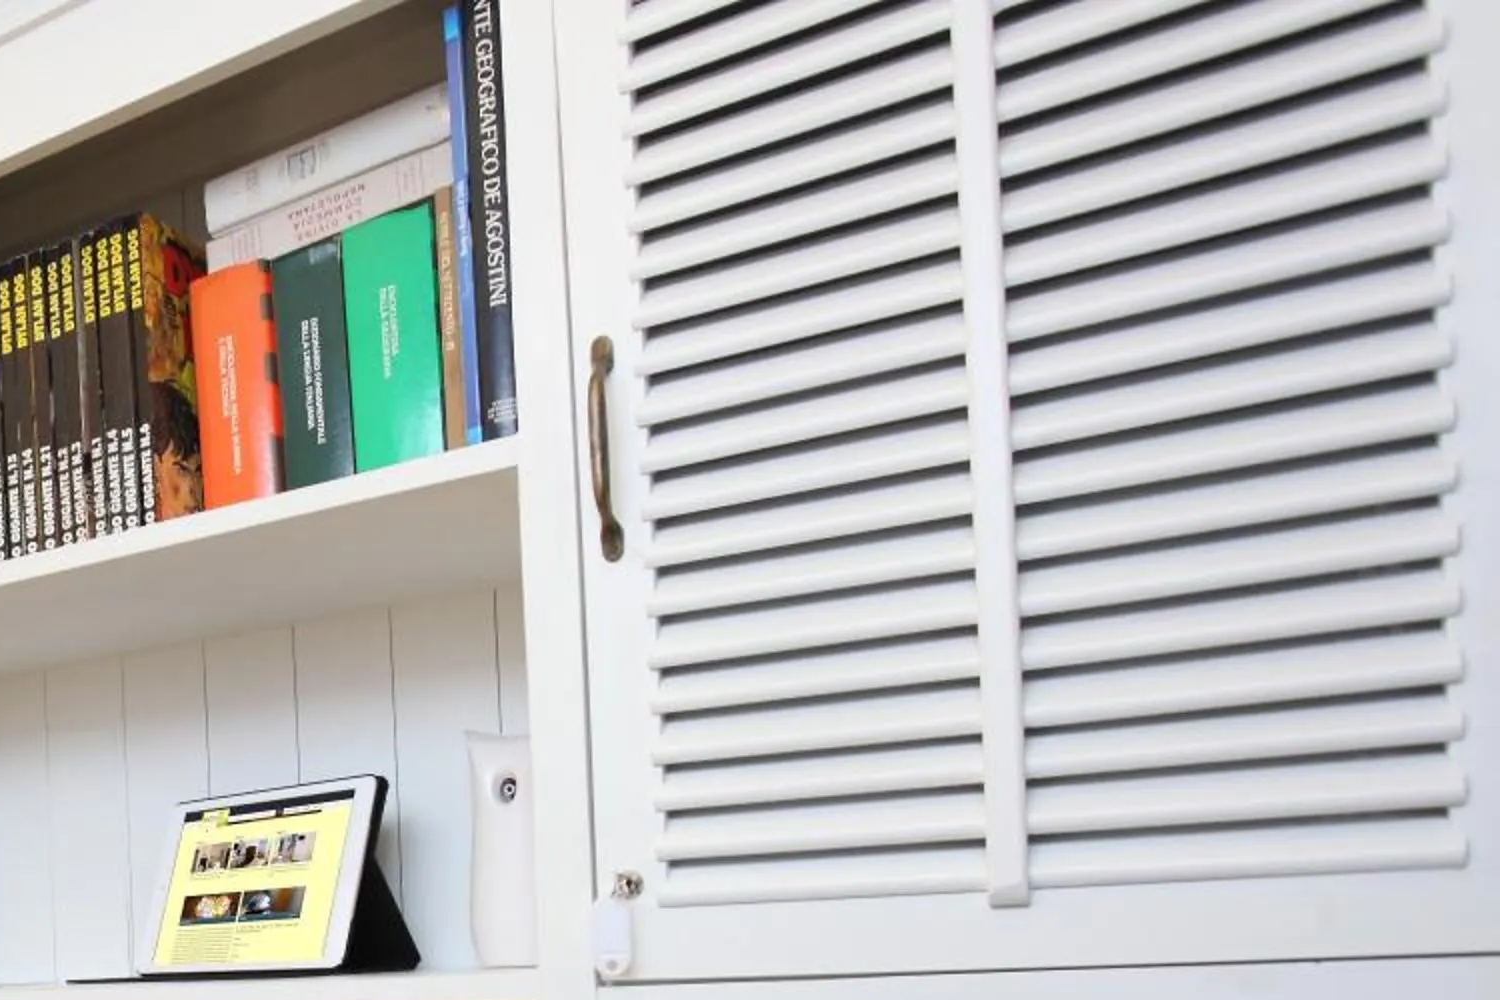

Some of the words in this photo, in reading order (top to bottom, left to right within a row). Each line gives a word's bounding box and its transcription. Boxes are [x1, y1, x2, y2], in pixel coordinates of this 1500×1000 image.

[474, 38, 498, 177] GEOGRAFICO
[482, 178, 501, 205] DE
[82, 246, 93, 276] DOG
[97, 238, 108, 268] DOG
[110, 234, 122, 264] DOG
[128, 229, 139, 259] DOG
[484, 206, 507, 308] AGOSTINI
[14, 274, 25, 302] DOG
[31, 267, 42, 296] DOG
[47, 262, 58, 290] DOG
[61, 254, 71, 283] DOG
[112, 266, 126, 313] DYLAN
[129, 262, 143, 309] DYLAN
[0, 280, 10, 309] DOG
[63, 288, 75, 331] DYLAN
[83, 278, 95, 323] DYLAN
[98, 271, 111, 316] DYLAN
[1, 311, 13, 354] DYLAN
[16, 306, 29, 348] DYLAN
[33, 299, 45, 342] DYLAN
[49, 295, 61, 338] DYLAN
[59, 473, 72, 529] GIGANTE
[72, 467, 86, 523] GIGANTE
[92, 461, 105, 517] GIGANTE
[106, 455, 120, 512] GIGANTE
[122, 454, 137, 512] GIGANTE
[139, 450, 154, 508] GIGANTE
[9, 488, 21, 543] GIGANTE
[24, 483, 37, 538] GIGANTE
[42, 480, 55, 535] GIGANTE
